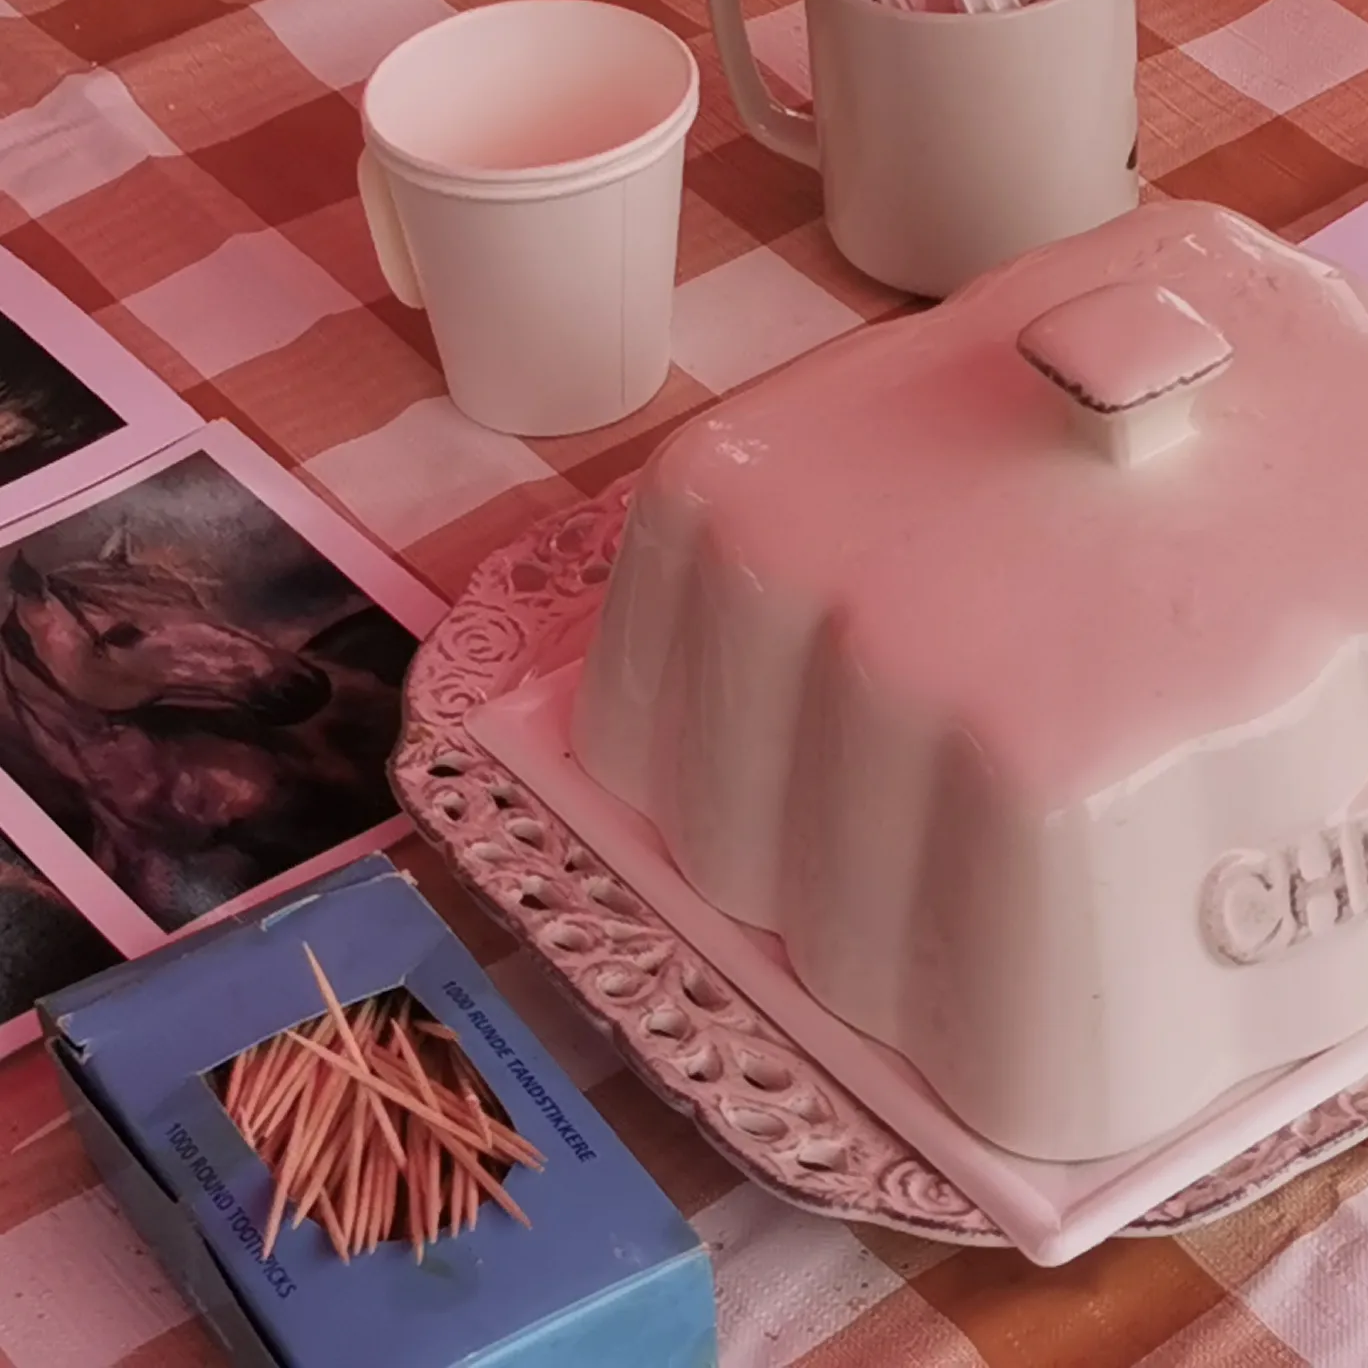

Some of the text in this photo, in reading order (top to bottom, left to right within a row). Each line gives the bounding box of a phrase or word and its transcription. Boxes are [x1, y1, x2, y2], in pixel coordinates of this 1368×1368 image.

[442, 980, 598, 1163] 1000 RUNDE TANDSTIKKERE
[166, 1122, 200, 1160] 1000
[189, 1156, 235, 1211] ROUND
